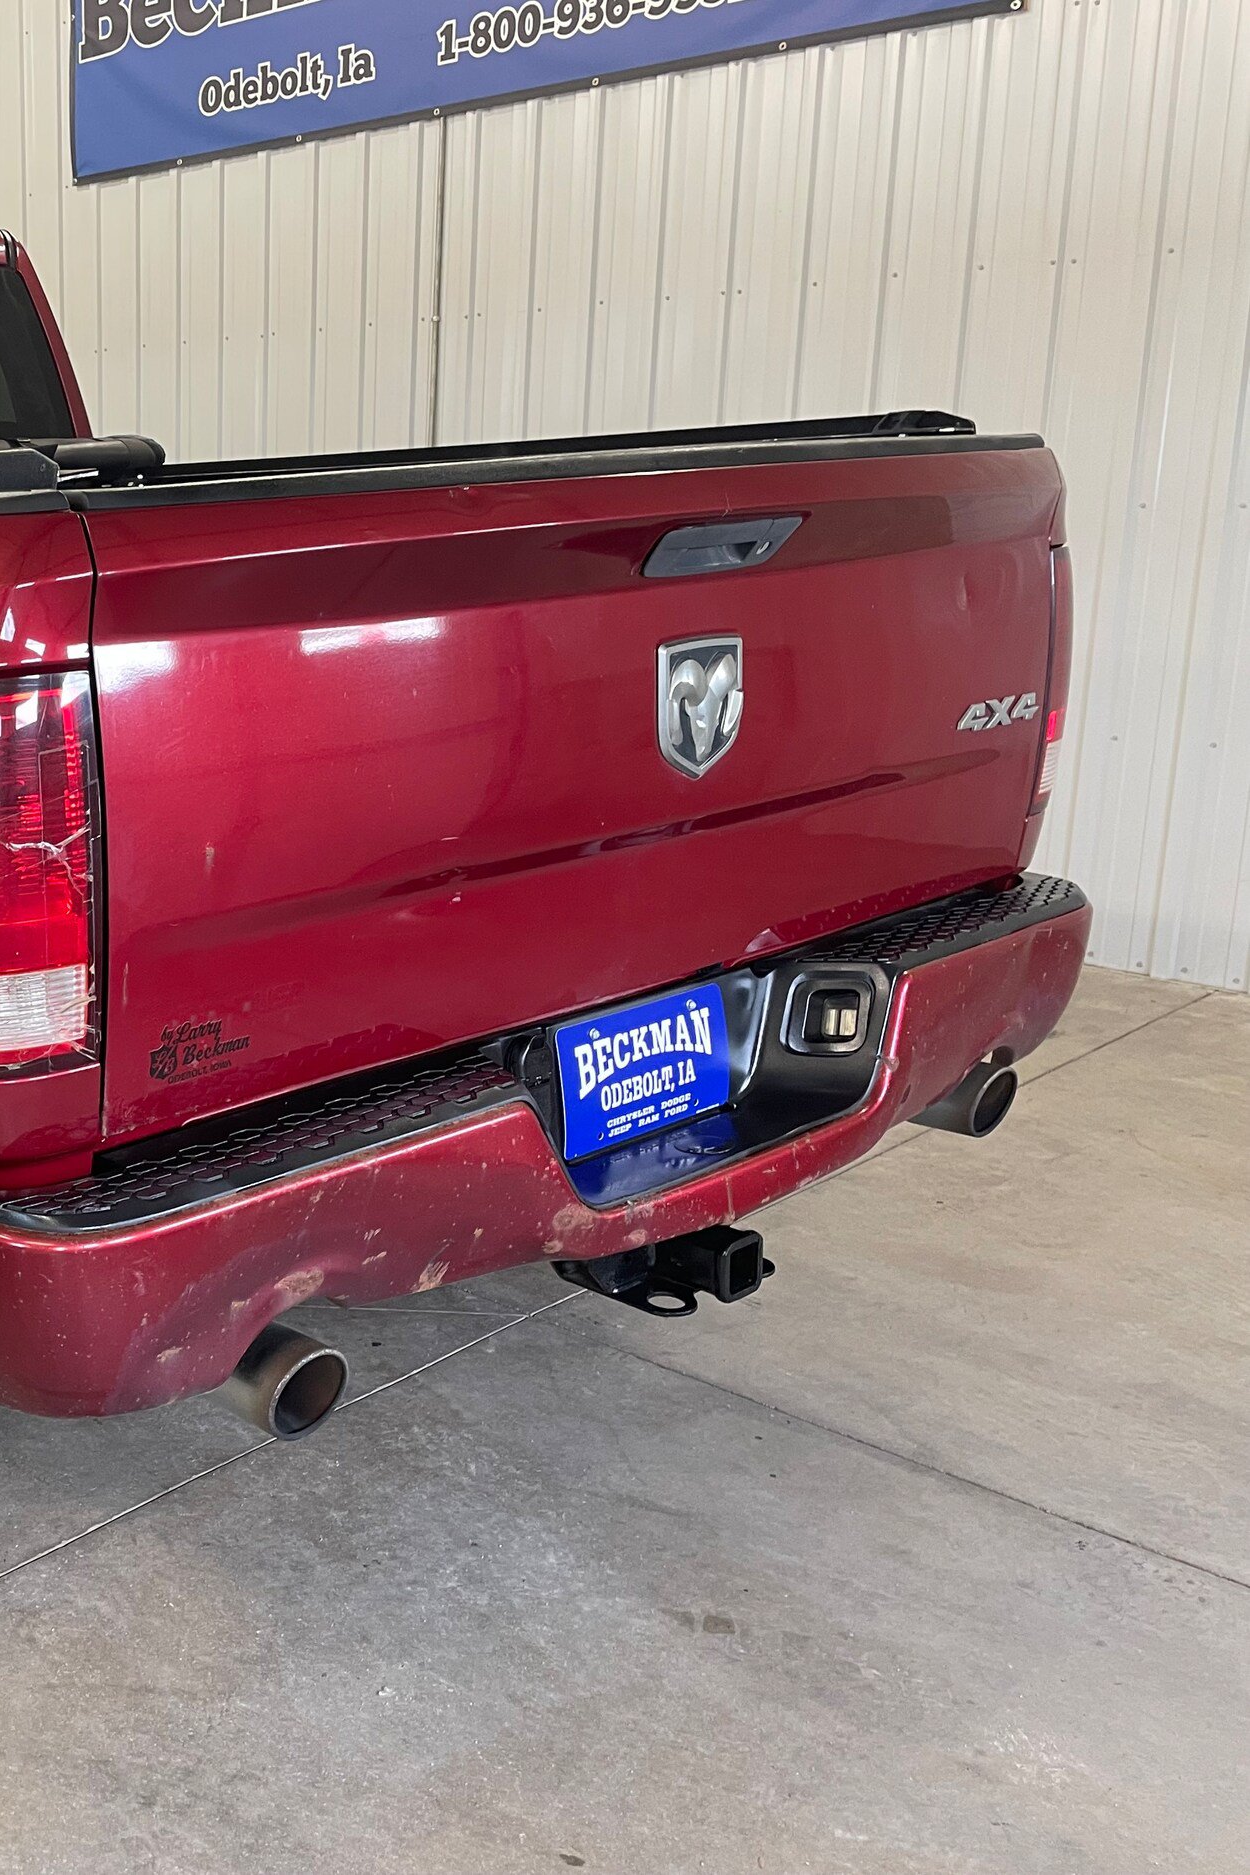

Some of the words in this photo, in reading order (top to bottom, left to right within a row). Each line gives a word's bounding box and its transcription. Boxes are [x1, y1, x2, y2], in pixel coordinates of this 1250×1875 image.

[436, 0, 742, 65] 1-800-936-
[198, 51, 333, 116] Odebolt,
[337, 43, 376, 88] Ia
[174, 1019, 222, 1044] Larry
[182, 1035, 250, 1066] Beckman
[574, 1007, 713, 1100] BECKMAN
[600, 1066, 676, 1112] ODEBOLT,
[678, 1058, 697, 1086] IA
[606, 1105, 655, 1129] CHRYSLER
[660, 1092, 692, 1109] DODGE
[608, 1123, 632, 1138] JEEP
[638, 1114, 660, 1128] RAM
[664, 1103, 688, 1119] FORD
